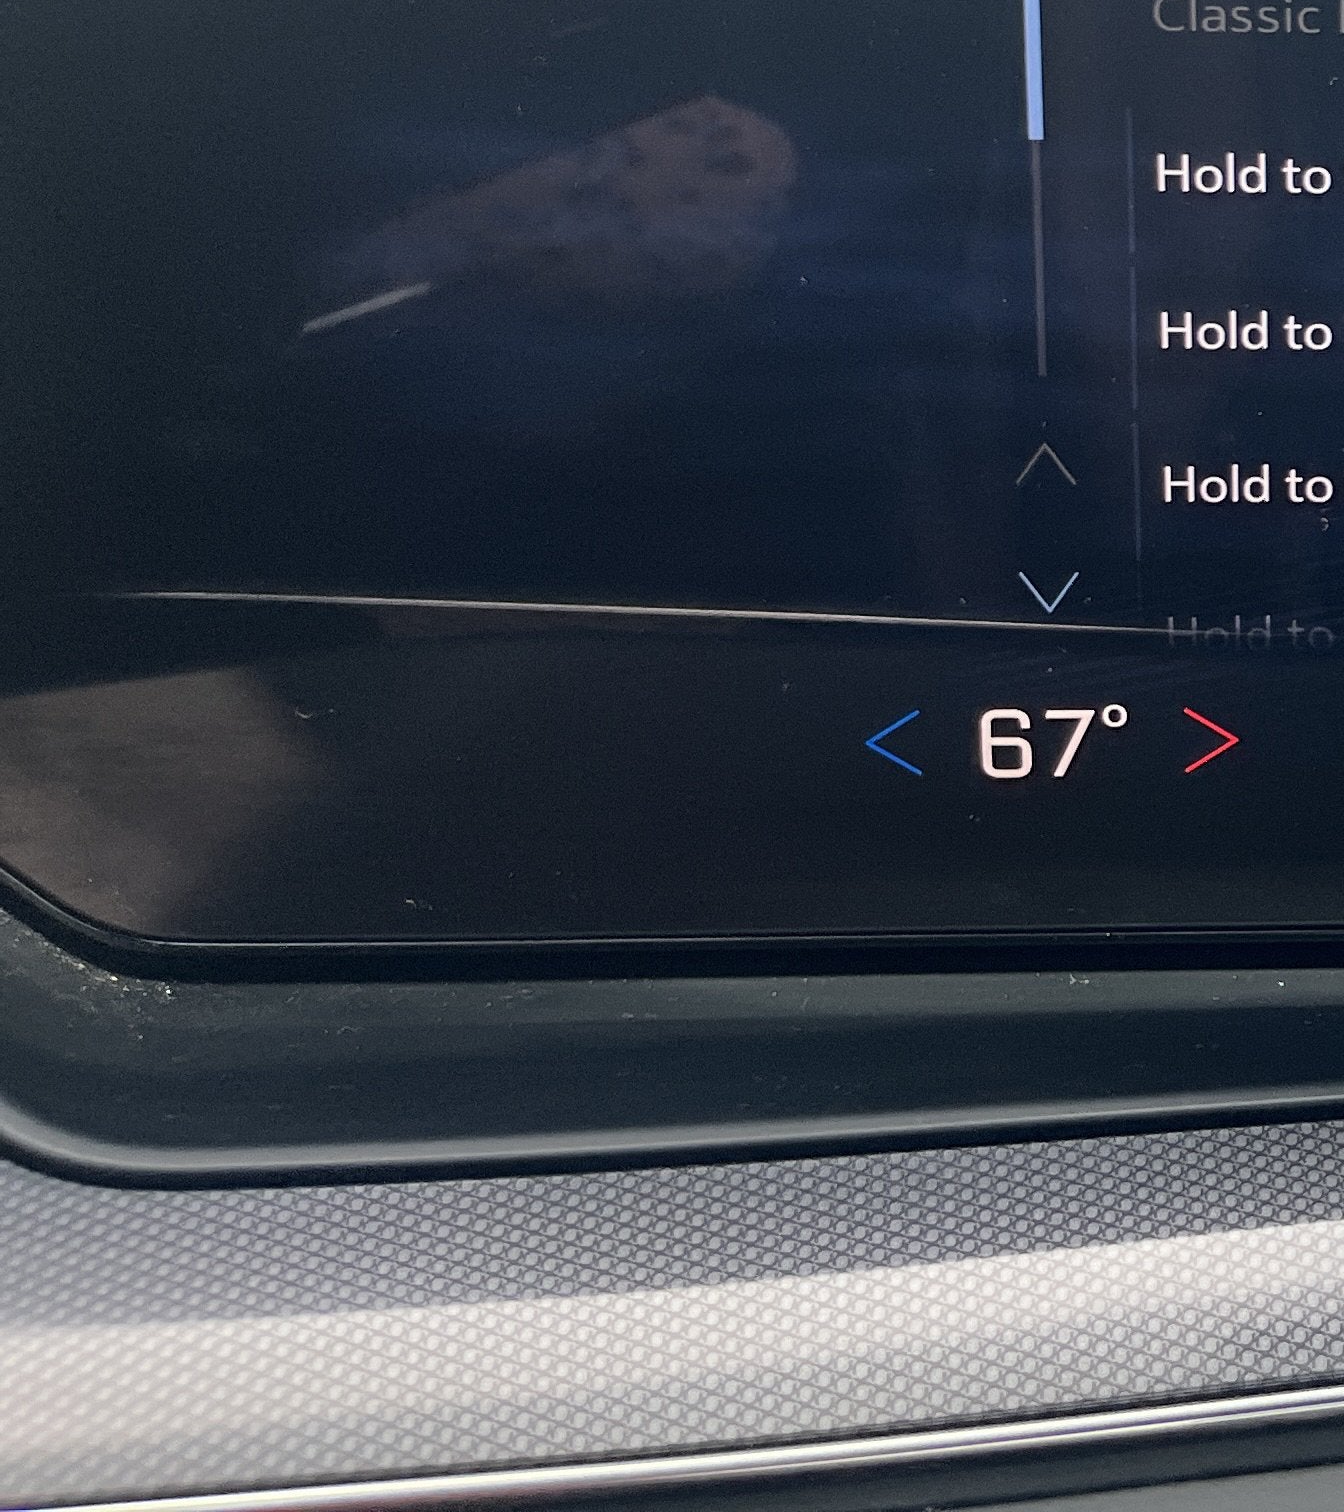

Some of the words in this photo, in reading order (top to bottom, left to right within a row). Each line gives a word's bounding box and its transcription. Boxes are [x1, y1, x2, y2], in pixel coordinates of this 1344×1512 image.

[1155, 152, 1268, 195] Hold
[1281, 160, 1334, 195] to
[1158, 309, 1270, 351] Hold
[1283, 316, 1334, 351] to
[1163, 463, 1271, 504] Hold
[1285, 470, 1335, 504] to
[1166, 615, 1273, 648] Hold
[1286, 621, 1336, 648] to
[978, 703, 1129, 780] 67°
